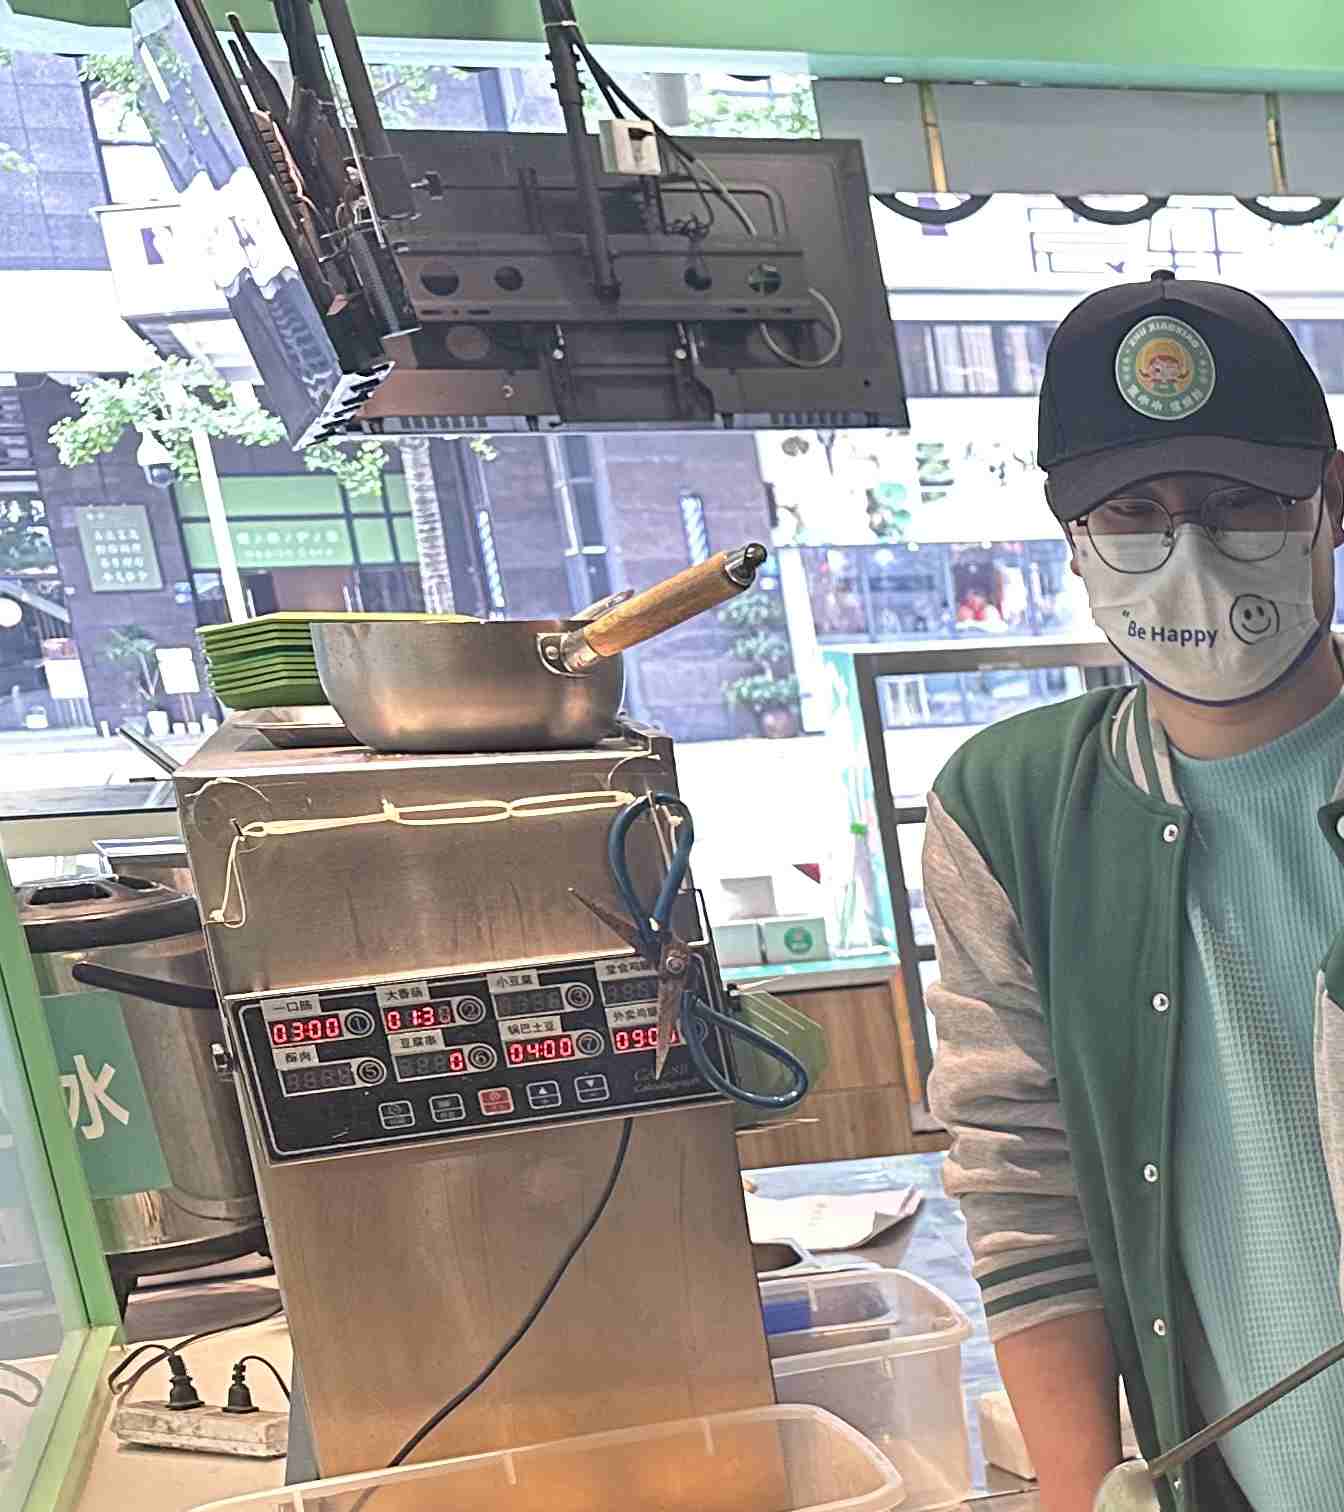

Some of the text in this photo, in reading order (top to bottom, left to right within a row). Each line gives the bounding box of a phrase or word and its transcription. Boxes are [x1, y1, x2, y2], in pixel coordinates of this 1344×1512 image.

[1151, 626, 1218, 648] Happy
[273, 1017, 340, 1044] 03:00
[508, 1037, 572, 1062] 04:00
[59, 1054, 130, 1140] 水
